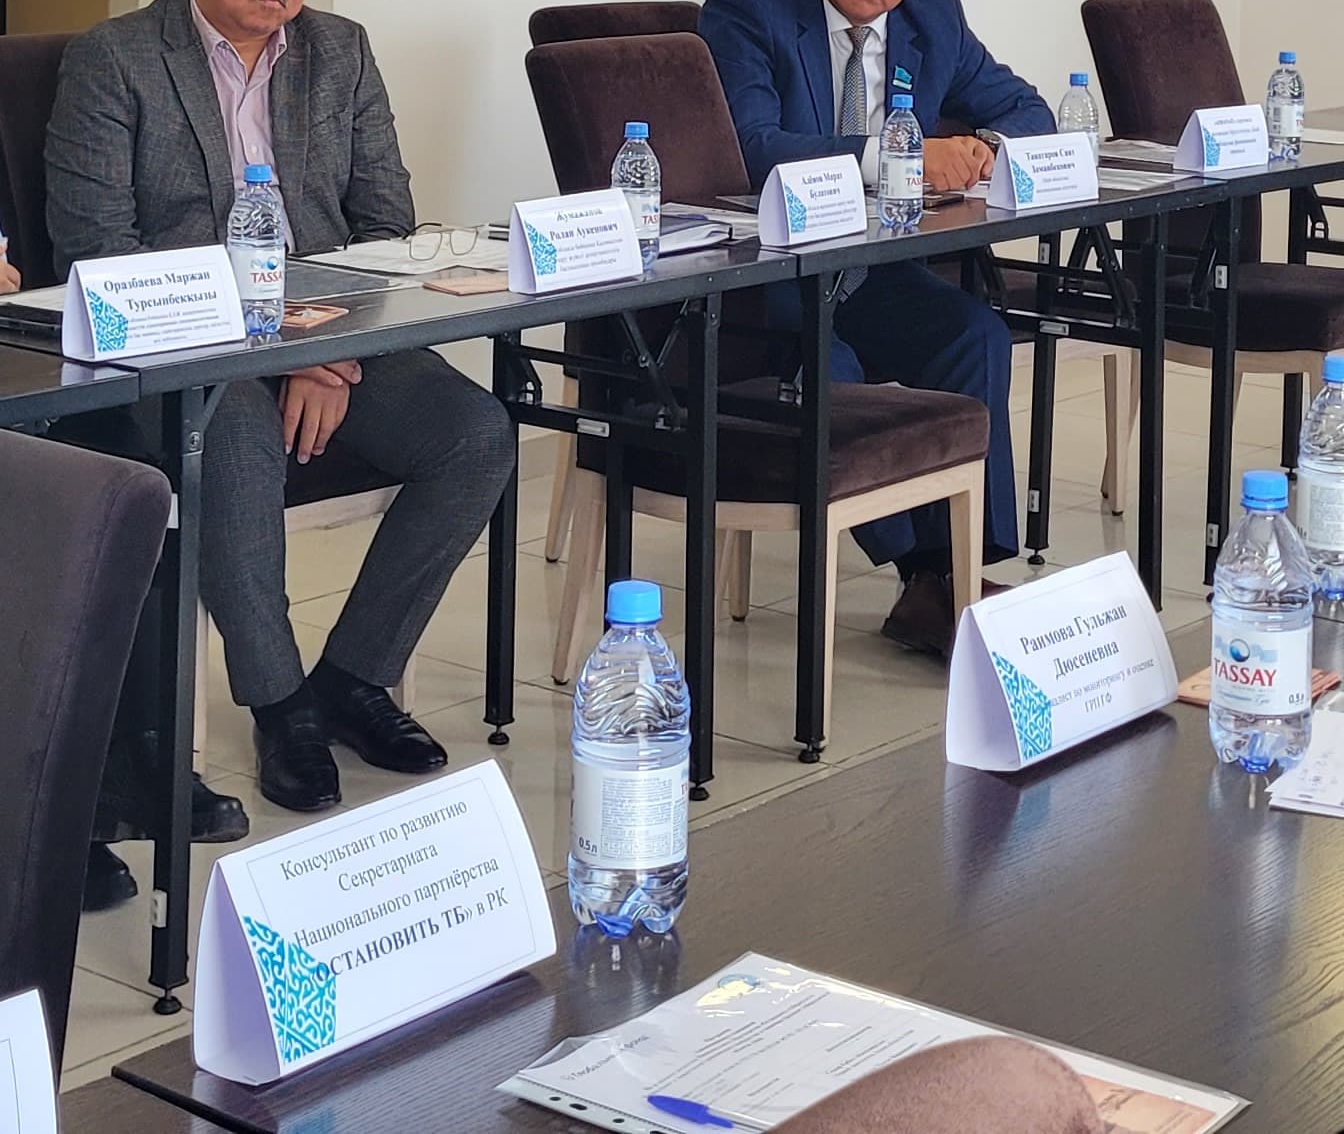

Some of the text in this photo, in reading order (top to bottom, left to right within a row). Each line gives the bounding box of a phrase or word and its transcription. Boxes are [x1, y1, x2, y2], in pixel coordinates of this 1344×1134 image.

[104, 270, 211, 295] Оразбаева Маржан
[1019, 604, 1128, 656] Раимова Гульжан
[1052, 640, 1120, 681] Дюсеневна
[1213, 657, 1277, 687] TASSAY
[280, 800, 468, 881] Консультант по развитию
[337, 842, 439, 892] Секретариата
[293, 857, 500, 950] Национального партнёрства
[441, 904, 474, 930] ТБ»
[476, 901, 487, 916] в
[486, 887, 510, 912] РК
